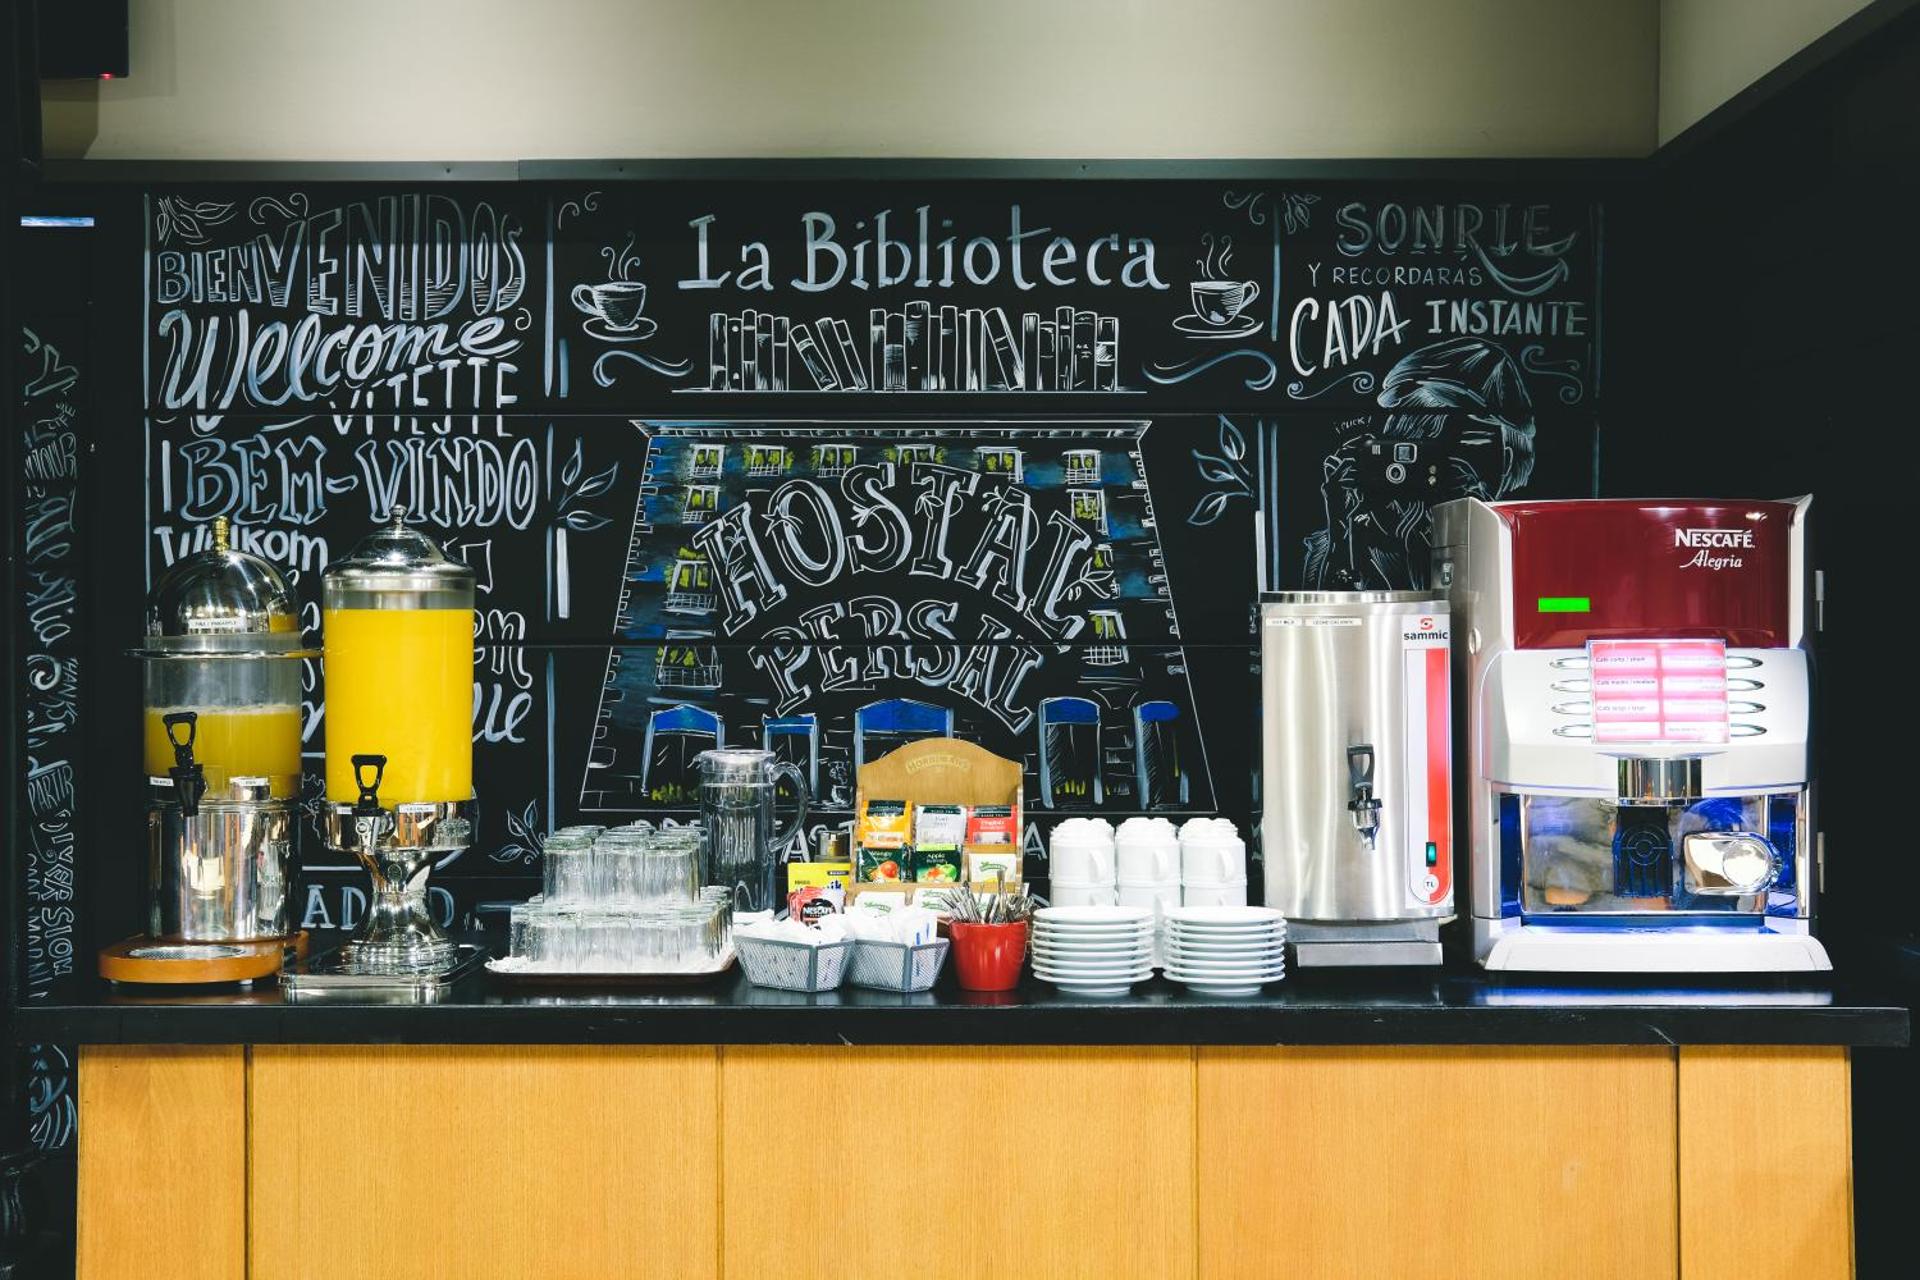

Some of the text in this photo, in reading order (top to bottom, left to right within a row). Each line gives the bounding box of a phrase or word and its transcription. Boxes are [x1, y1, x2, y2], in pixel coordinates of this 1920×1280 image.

[158, 193, 526, 321] BIENVENIDOS
[678, 204, 1170, 292] La Biblioteca
[1308, 261, 1321, 287] Y
[1336, 202, 1577, 282] SONRIE
[158, 309, 522, 432] Welcome
[1290, 290, 1587, 376] CADA INSTANTE
[179, 434, 538, 528] BEM-VINDO
[692, 461, 1092, 653] HOSTAL
[1674, 528, 1755, 548] NESCAFÉ
[1679, 549, 1743, 570] Alegria
[748, 595, 1045, 736] PERSAL
[1403, 629, 1449, 641] sammic
